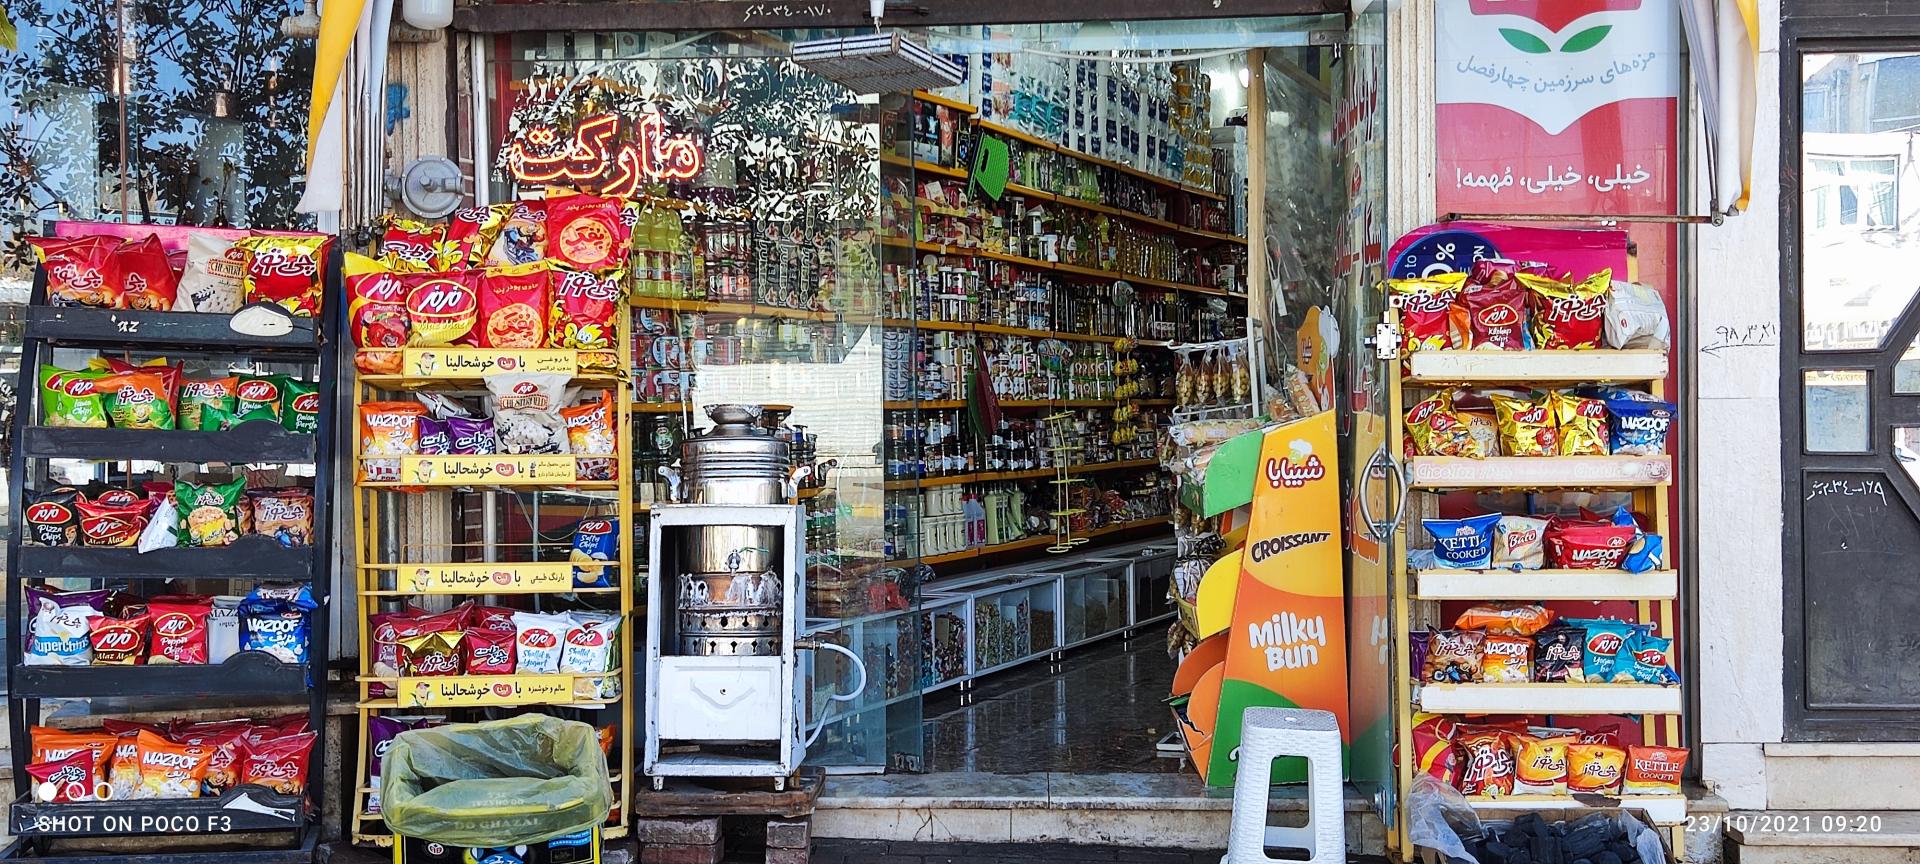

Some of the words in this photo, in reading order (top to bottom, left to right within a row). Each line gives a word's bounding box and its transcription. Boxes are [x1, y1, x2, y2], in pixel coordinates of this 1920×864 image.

[509, 111, 703, 199] مارکت
[418, 285, 463, 313] مزمز
[1484, 306, 1510, 323] مزمز
[445, 354, 495, 372] خوشحالینا
[518, 355, 526, 372] با
[1621, 417, 1670, 431] MAZPOF
[443, 461, 493, 479] خوشحالینا
[517, 461, 525, 479] با
[33, 505, 59, 521] مزمز
[1251, 532, 1331, 563] CROISSANT
[1446, 546, 1487, 559] COOKED
[1573, 548, 1624, 560] MAZPOF
[440, 570, 490, 587] خوشحالینا
[514, 570, 521, 586] با
[1249, 611, 1327, 649] Milky
[1264, 645, 1319, 672] Bun
[441, 683, 490, 700] خوشحالینا
[515, 681, 522, 699] با
[143, 751, 199, 769] MAZPOF
[1634, 759, 1681, 772] KETTLE
[1639, 773, 1674, 781] COOKED
